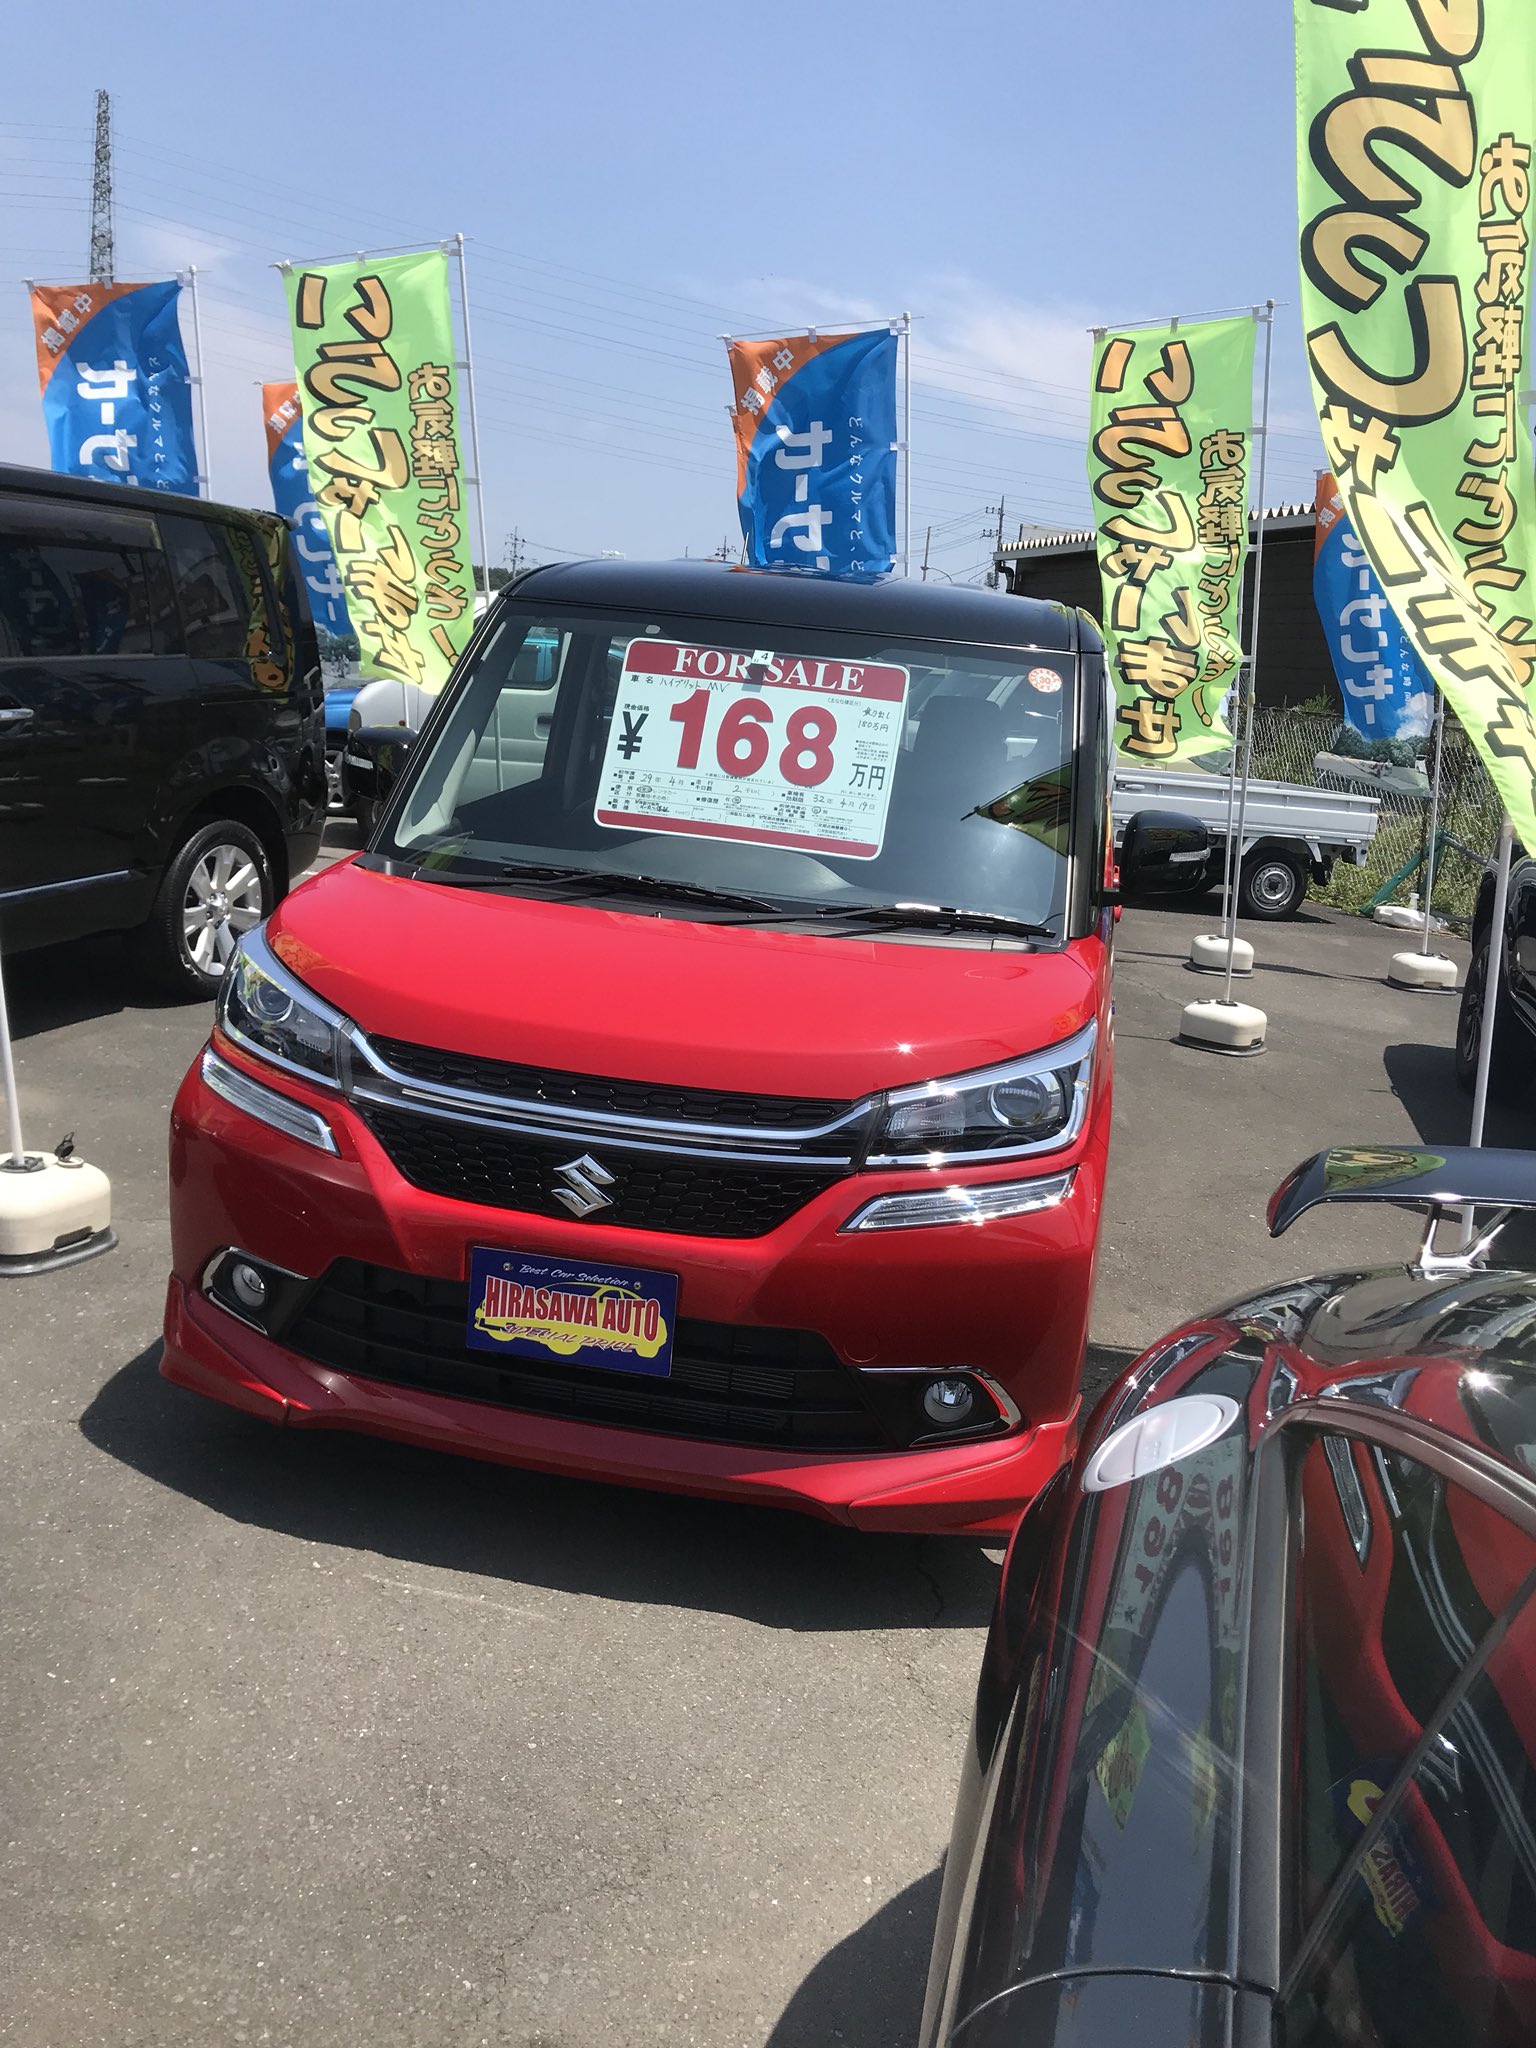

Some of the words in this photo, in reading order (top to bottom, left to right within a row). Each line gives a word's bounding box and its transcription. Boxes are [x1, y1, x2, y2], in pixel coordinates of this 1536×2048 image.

[741, 348, 794, 416] 掲載中
[672, 647, 752, 681] FOR
[763, 656, 865, 693] SALE
[669, 688, 838, 787] 168
[848, 763, 886, 791] 万円
[550, 1269, 575, 1280] Car
[575, 1271, 629, 1287] Selection
[484, 1275, 598, 1328] HIRASAWA
[601, 1297, 661, 1342] AUTO
[500, 1322, 578, 1344] SPECIAL
[577, 1335, 639, 1353] PRICE
